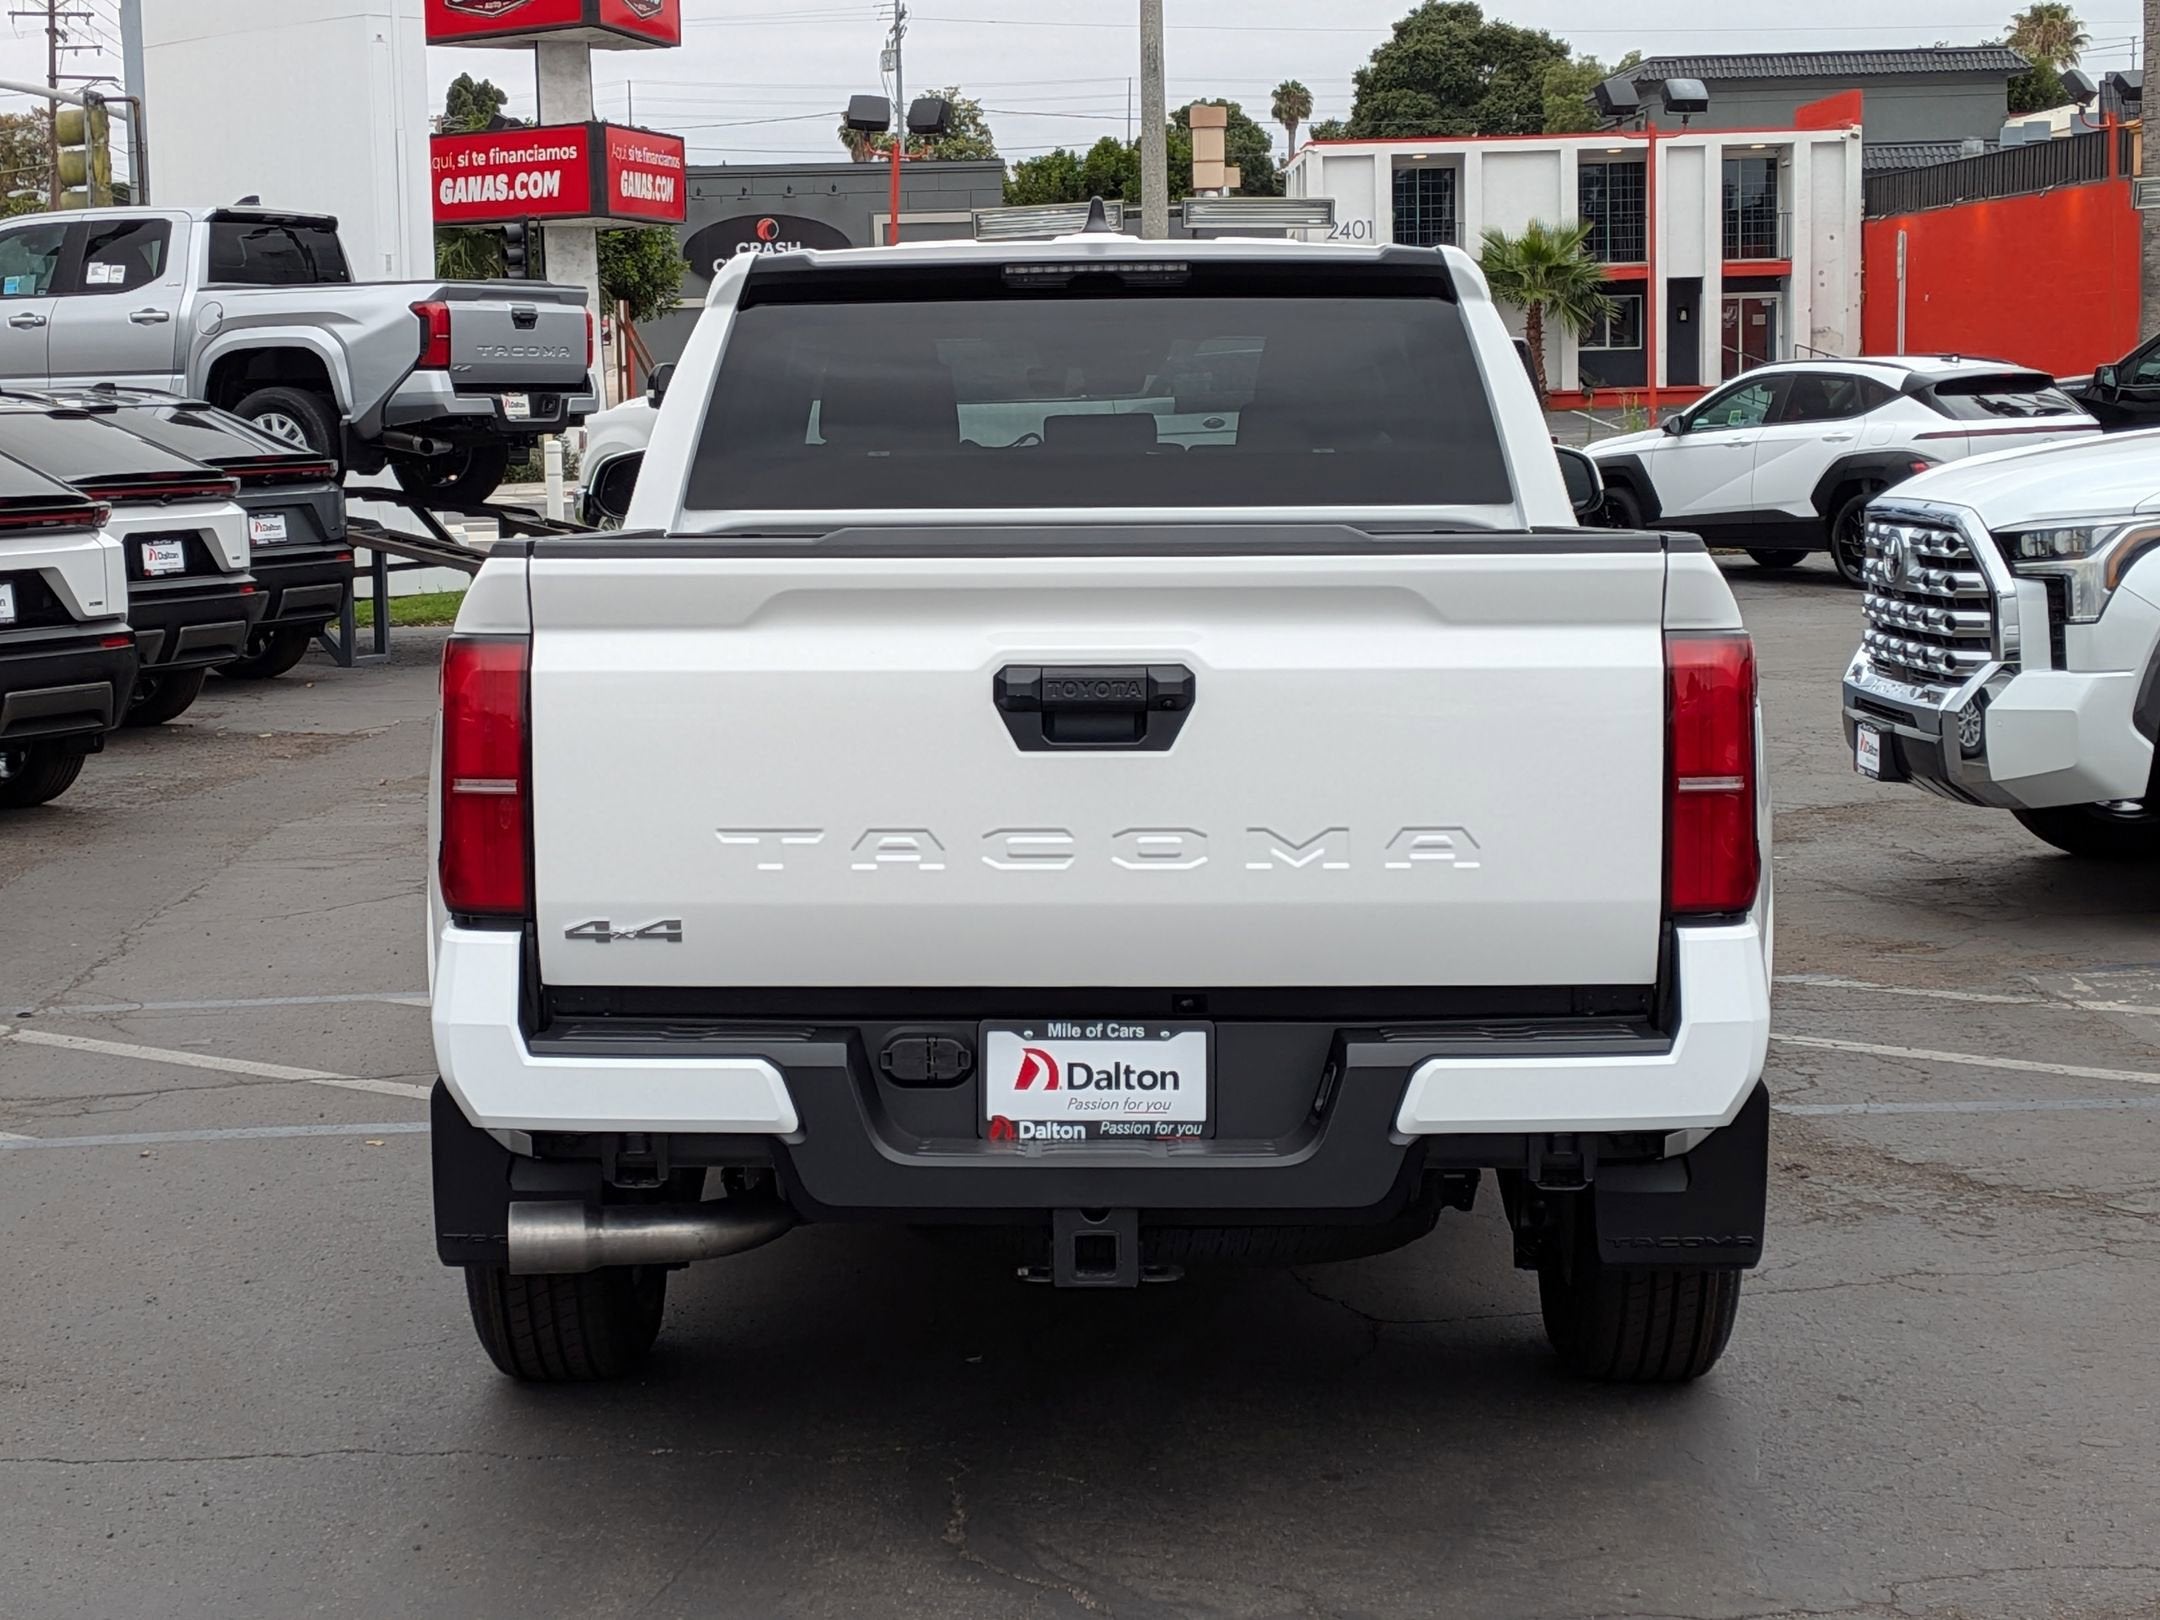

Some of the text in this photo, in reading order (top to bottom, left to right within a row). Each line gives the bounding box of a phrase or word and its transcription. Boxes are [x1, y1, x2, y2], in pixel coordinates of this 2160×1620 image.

[431, 144, 577, 172] quí, sí te financiamos
[439, 170, 561, 205] GANAS.COM
[620, 169, 675, 203] GANAS.COM
[1327, 219, 1373, 240] 2401
[735, 241, 801, 255] CRASH
[476, 345, 571, 358] TACOMA
[1047, 680, 1143, 699] TOYOTA
[715, 826, 1481, 870] TACOMA
[1047, 1023, 1145, 1038] Mile of Cars
[1066, 1061, 1180, 1091] Dalton
[1066, 1097, 1172, 1113] Passion for you
[1018, 1121, 1203, 1139] Dalton Passion for you
